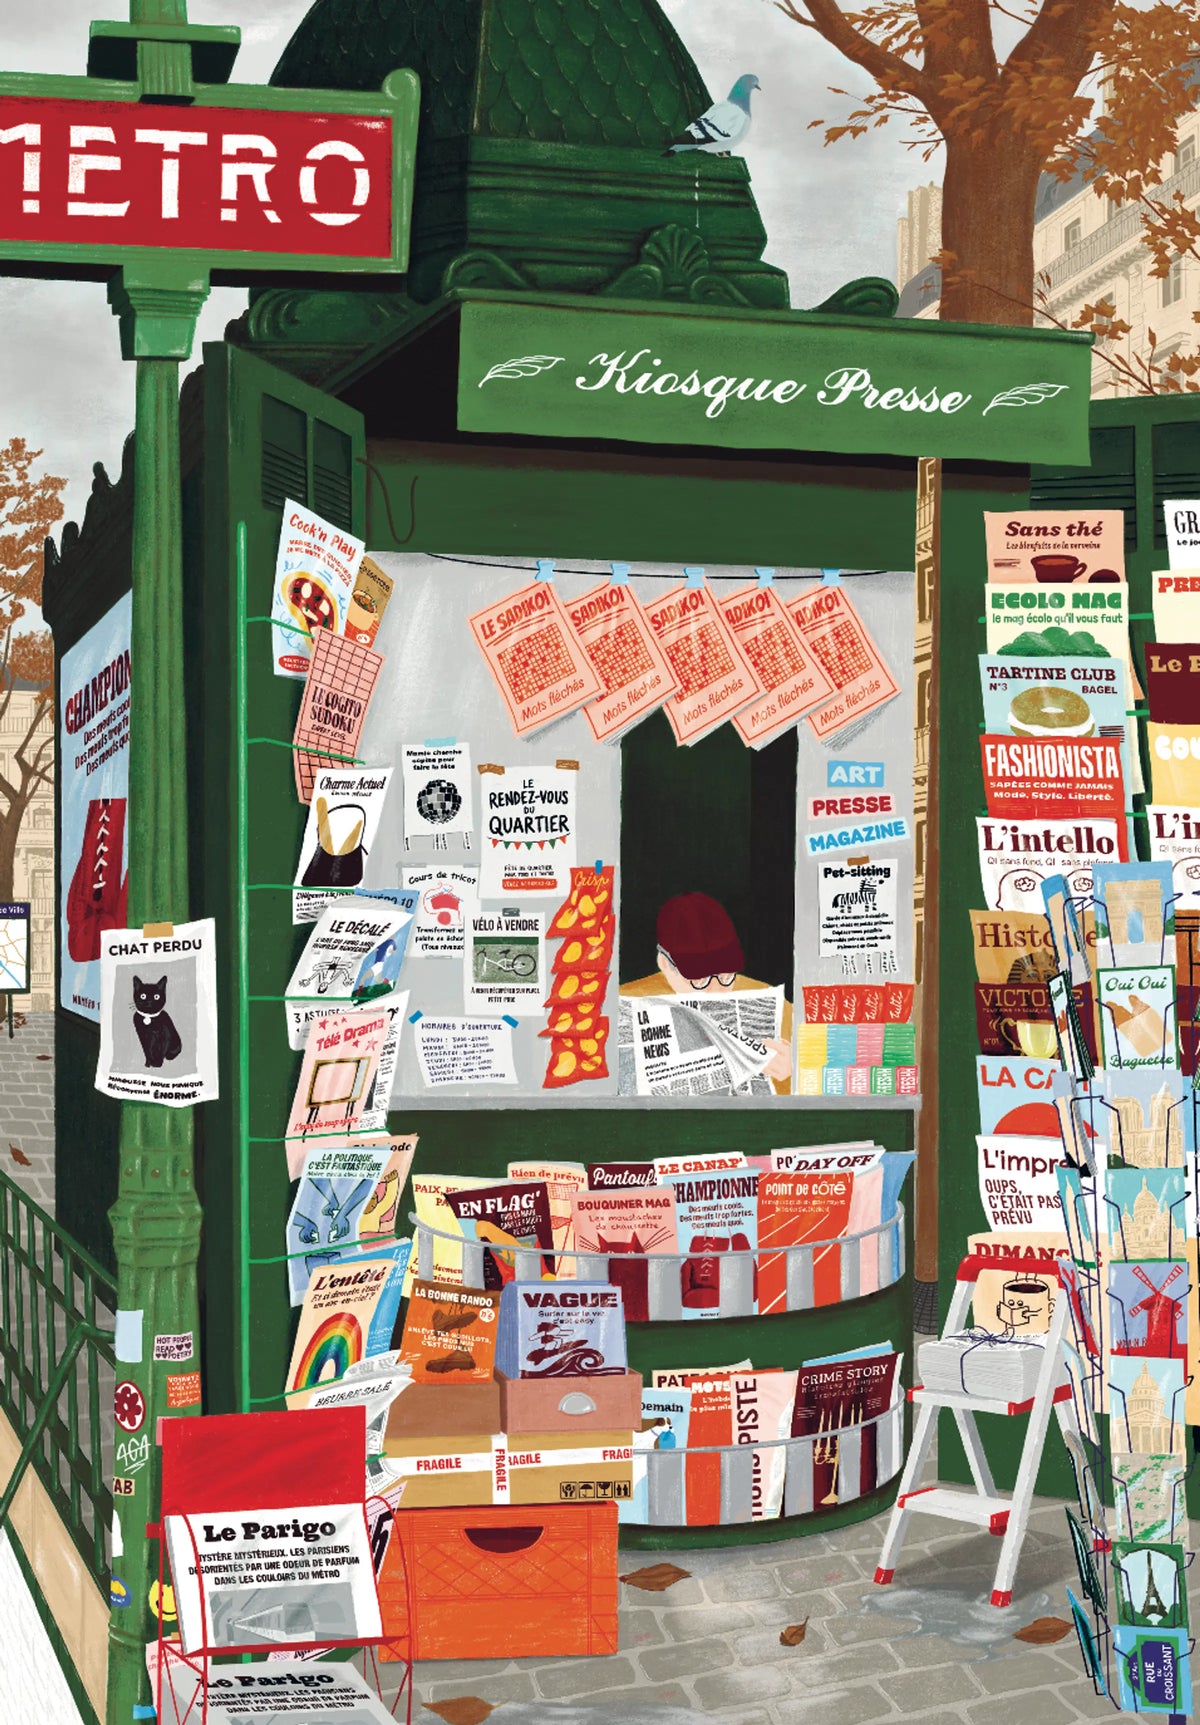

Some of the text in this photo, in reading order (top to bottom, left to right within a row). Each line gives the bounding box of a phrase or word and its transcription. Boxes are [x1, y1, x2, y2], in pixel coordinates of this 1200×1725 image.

[575, 349, 972, 418] Kiosque Presse
[1005, 520, 1104, 537] Sans thé
[289, 513, 356, 562] Cook'n Play
[991, 592, 1122, 609] ECOLO MAG
[993, 613, 1123, 626] le mag écolo qu'il vous faut
[480, 622, 496, 640] LE
[987, 666, 1116, 682] TARTINE CLUB
[1082, 685, 1118, 694] BAGEL
[325, 691, 362, 718] COGITO
[521, 700, 547, 722] Mots
[603, 700, 627, 725] Mots
[310, 705, 356, 734] SUDOKU
[683, 703, 708, 725] Mots
[750, 703, 777, 727] Mots
[819, 703, 845, 727] Mots
[984, 743, 1120, 779] FASHIONISTA
[319, 776, 387, 790] Charme Actuel
[523, 779, 534, 789] LE
[831, 766, 881, 785] ART
[1033, 782, 1073, 790] COMME
[489, 790, 569, 809] RENDEZ-VOUS
[813, 796, 892, 816] PRESSE
[523, 806, 535, 814] DU
[489, 815, 570, 836] QUARTIER
[809, 821, 906, 852] MAGAZINE
[981, 824, 1115, 855] L'intello
[408, 873, 433, 885] Cours
[436, 871, 447, 879] de
[823, 865, 891, 879] Pet-sitting
[574, 871, 610, 893] Crisp
[400, 898, 414, 909] 10
[329, 920, 391, 936] LE DÉCALÉ
[473, 917, 539, 931] VÉLO À VENDRE
[109, 939, 202, 956] CHAT PERDU
[1105, 976, 1167, 992] Oui Oui
[294, 1013, 301, 1023] 3
[637, 1010, 650, 1025] LA
[316, 1018, 384, 1051] Télé Drama
[641, 1025, 672, 1042] BONNE
[643, 1042, 671, 1059] NEWS
[1110, 1055, 1175, 1070] Baguette
[980, 1065, 1016, 1088] LA
[322, 1153, 332, 1162] LA
[658, 1157, 743, 1175] LE CANAP'
[794, 1154, 875, 1171] DAY OFF
[308, 1162, 382, 1172] C'EST FANTASTIQUE
[511, 1168, 551, 1179] Rien de
[673, 1177, 759, 1203] HAMPIONNE
[985, 1179, 1022, 1195] OUPS,
[458, 1190, 540, 1217] EN FLAG'
[577, 1198, 671, 1211] BOUQUINER MAG
[988, 1192, 1062, 1209] C'ÉTAIT PAS
[993, 1209, 1033, 1225] PRÉVU
[312, 1266, 387, 1291] L'entêté
[415, 1287, 493, 1307] LA BONNE RANDO
[523, 1293, 618, 1308] VAGUE
[156, 1336, 171, 1344] HOT
[801, 1364, 889, 1386] CRIME STORY
[736, 1378, 759, 1445] PISTE
[416, 1457, 462, 1471] FRAGILE
[495, 1448, 507, 1491] FRAGILE
[203, 1519, 336, 1543] Le Parigo
[290, 1547, 305, 1557] LES
[307, 1545, 350, 1556] PARISIENS
[246, 1556, 360, 1572] PAR UNE ODEUR DE PARFUM
[214, 1569, 340, 1586] DANS LES COULOIRS DU MÉTRO
[234, 1673, 335, 1688] Parigo
[1145, 1662, 1156, 1683] RUE
[1162, 1644, 1174, 1701] CROISSANT
